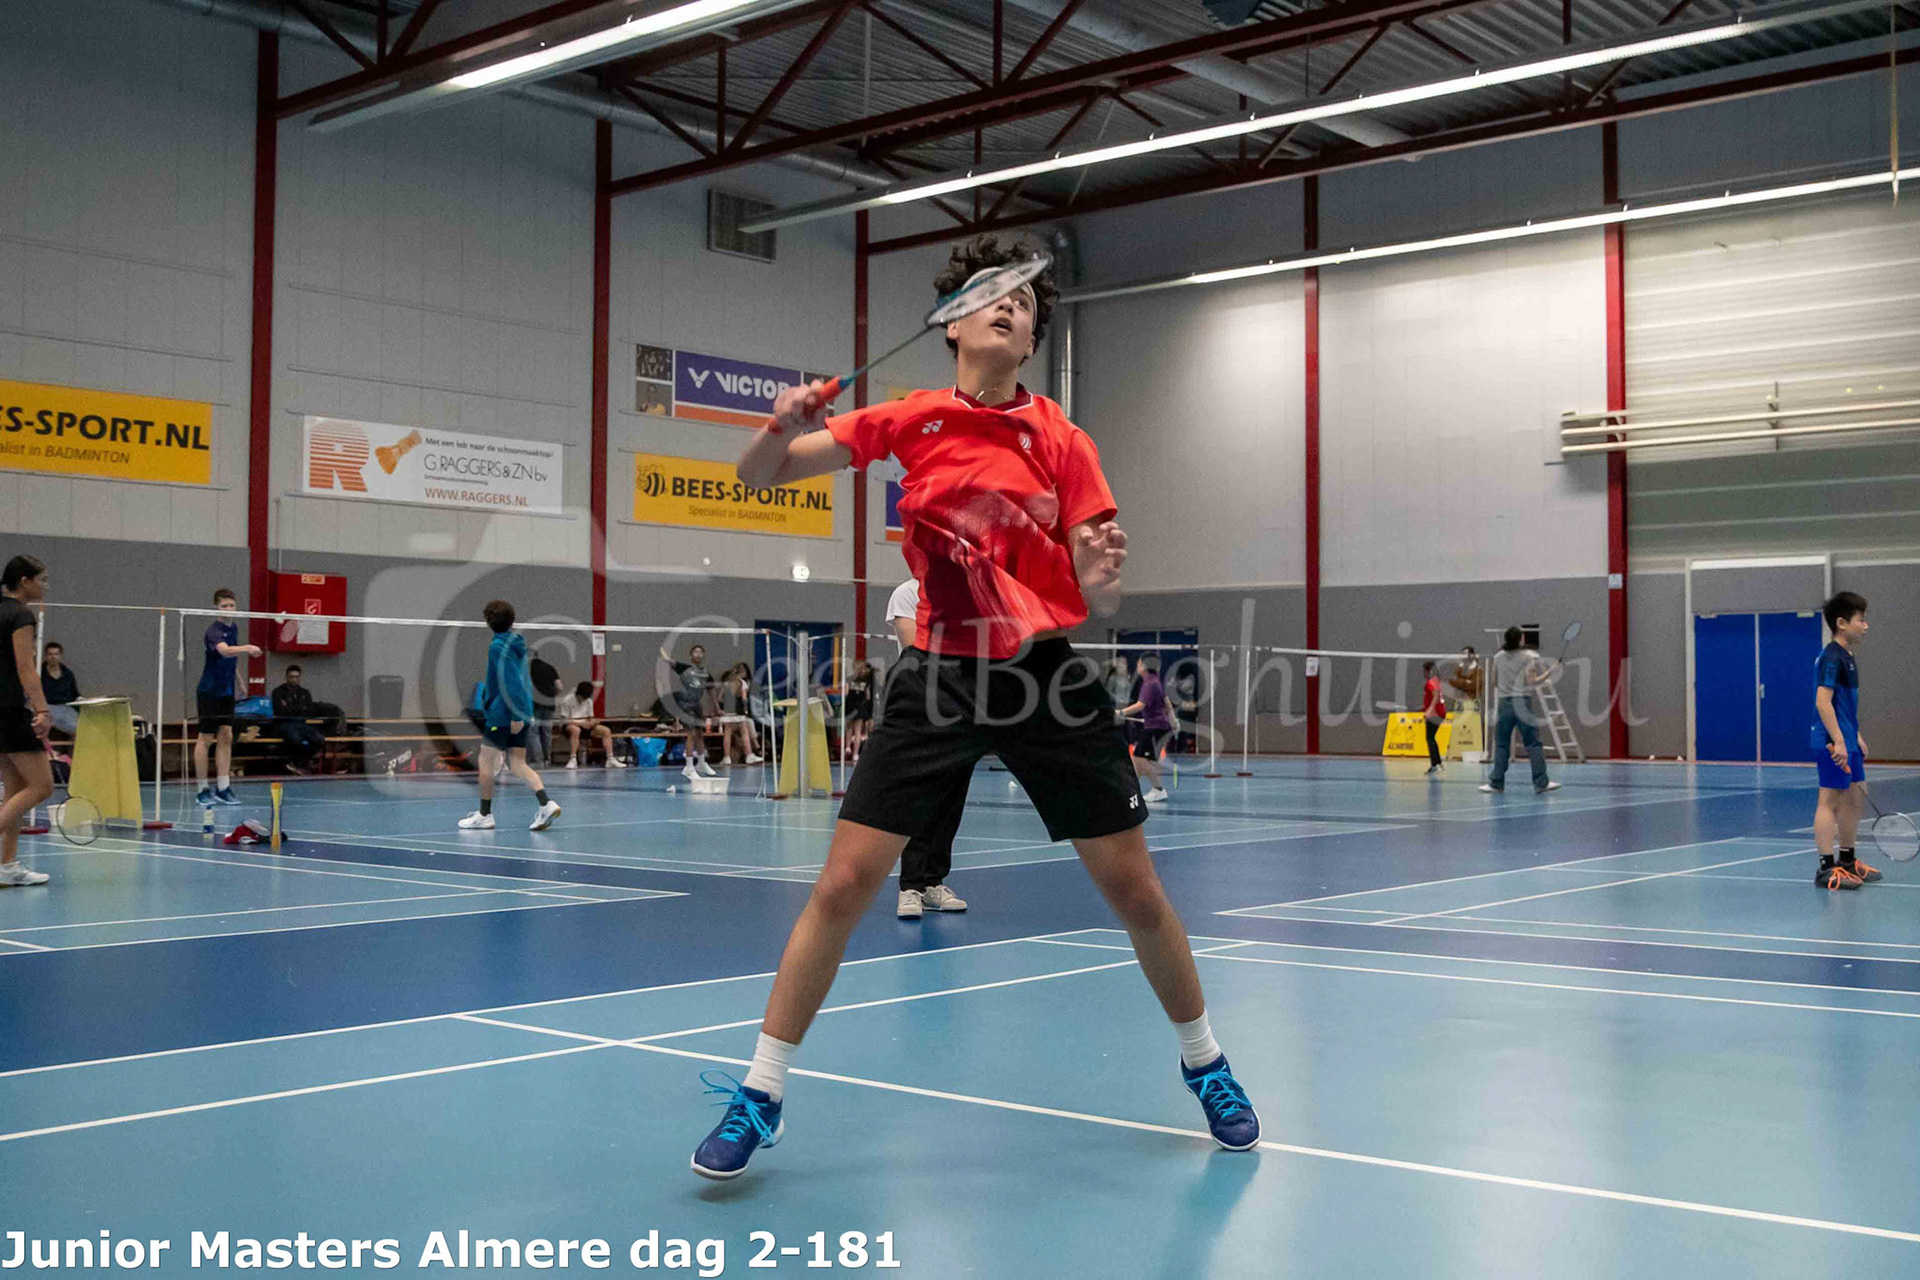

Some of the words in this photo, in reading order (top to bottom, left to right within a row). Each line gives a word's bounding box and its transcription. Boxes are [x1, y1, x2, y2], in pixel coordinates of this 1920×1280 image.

[0, 405, 210, 450] S-SPORT.NL
[44, 445, 130, 464] BADMINTON
[425, 487, 529, 507] WWW.RAGGERS.NL
[671, 476, 833, 511] BEES-SPORT.NL
[737, 510, 788, 523] BADMINTON
